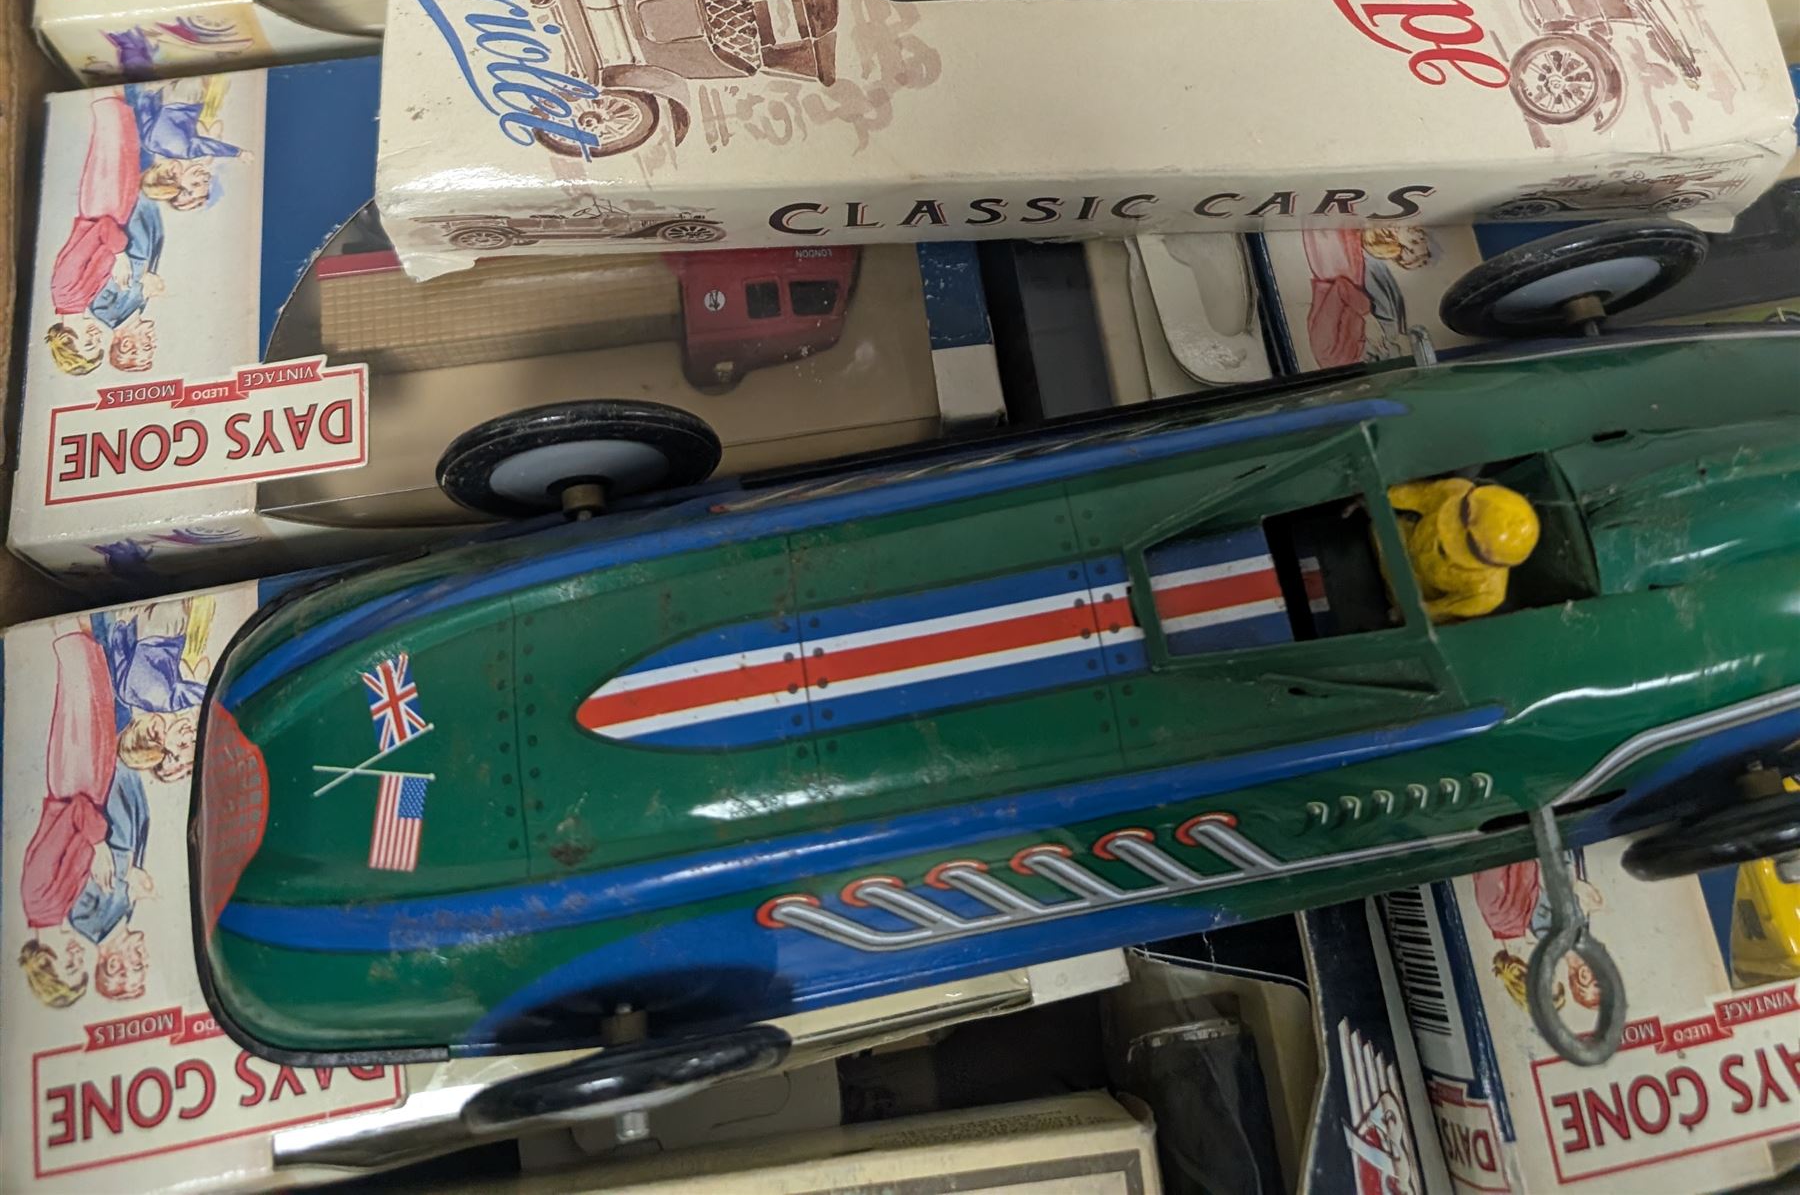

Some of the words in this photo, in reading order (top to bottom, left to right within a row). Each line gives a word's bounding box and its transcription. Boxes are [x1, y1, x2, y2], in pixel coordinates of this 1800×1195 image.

[769, 192, 1161, 237] CLASSIC
[1193, 185, 1436, 220] CARS
[795, 248, 833, 259] LONDON
[243, 364, 314, 387] VINTAGE
[107, 384, 176, 403] MODELS
[191, 386, 229, 401] LLEDO
[225, 399, 353, 460] DAYS
[59, 419, 209, 482] GONE
[1723, 990, 1793, 1020] VINTAGE
[95, 1012, 174, 1044] MODELS
[1673, 1023, 1713, 1043] LLEDO
[1719, 1042, 1800, 1114] AYS
[48, 1059, 217, 1148] GONE
[1552, 1065, 1709, 1153] GONE
